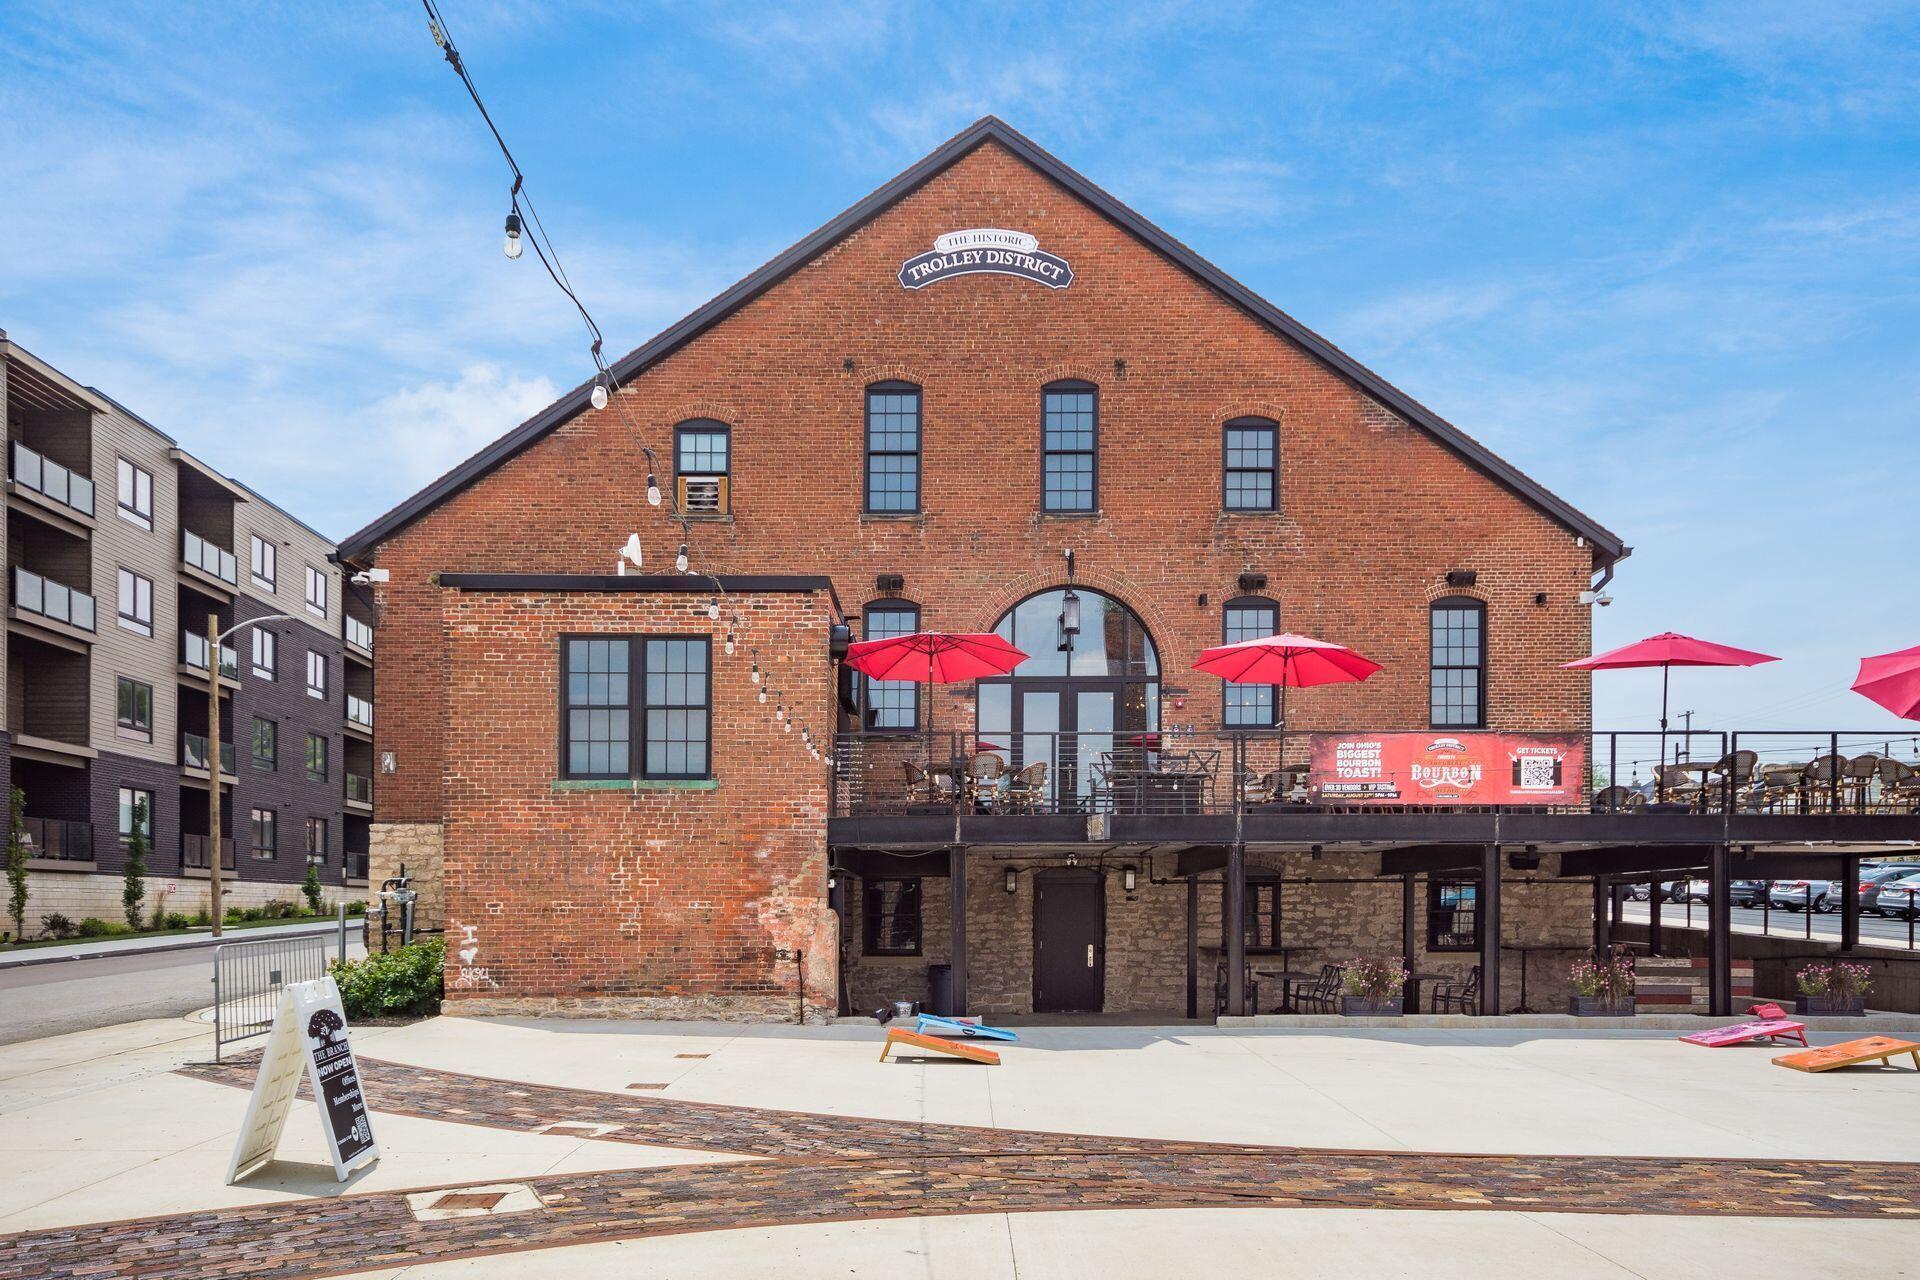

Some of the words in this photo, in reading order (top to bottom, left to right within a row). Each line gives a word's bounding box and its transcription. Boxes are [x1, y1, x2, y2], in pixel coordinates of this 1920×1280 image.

[947, 234, 969, 247] THE
[973, 234, 1028, 247] HISTORIC
[907, 250, 984, 281] TROLLEY
[986, 250, 1064, 281] DISTRICT
[1336, 742, 1355, 750] JOIN
[1531, 747, 1558, 755] TICKETS
[1336, 750, 1382, 759] BIGGEST
[1336, 759, 1382, 767] BOURBON
[1336, 768, 1382, 778] TOAST!
[313, 1049, 327, 1062] THE
[326, 1041, 349, 1057] BRANCH
[317, 1063, 334, 1077] NOW
[334, 1056, 352, 1071] OPEN
